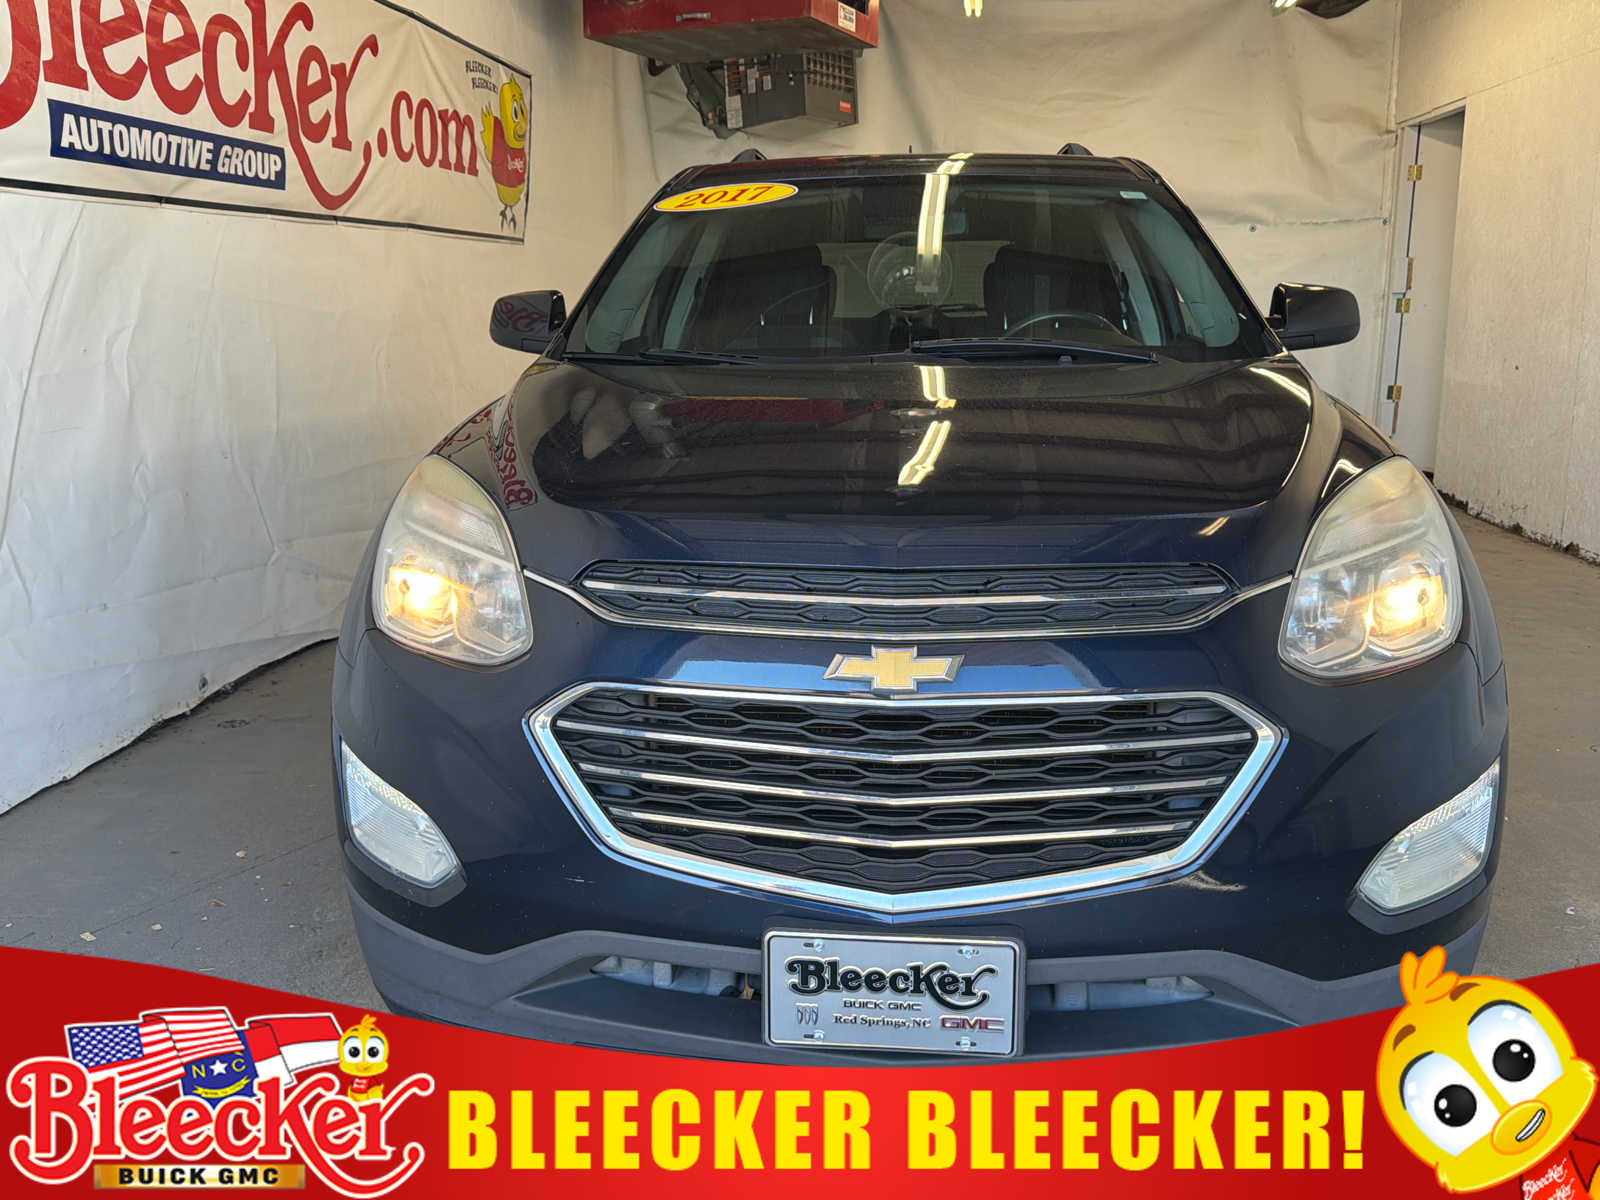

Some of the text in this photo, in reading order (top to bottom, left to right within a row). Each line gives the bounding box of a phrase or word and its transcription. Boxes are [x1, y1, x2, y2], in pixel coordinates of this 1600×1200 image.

[60, 113, 282, 182] AUTOMOTIVE GROUP
[674, 186, 774, 208] 2017
[843, 999, 922, 1012] BUICK GMC
[833, 1014, 932, 1029] Red Springs, NC
[940, 1016, 1005, 1031] GMC
